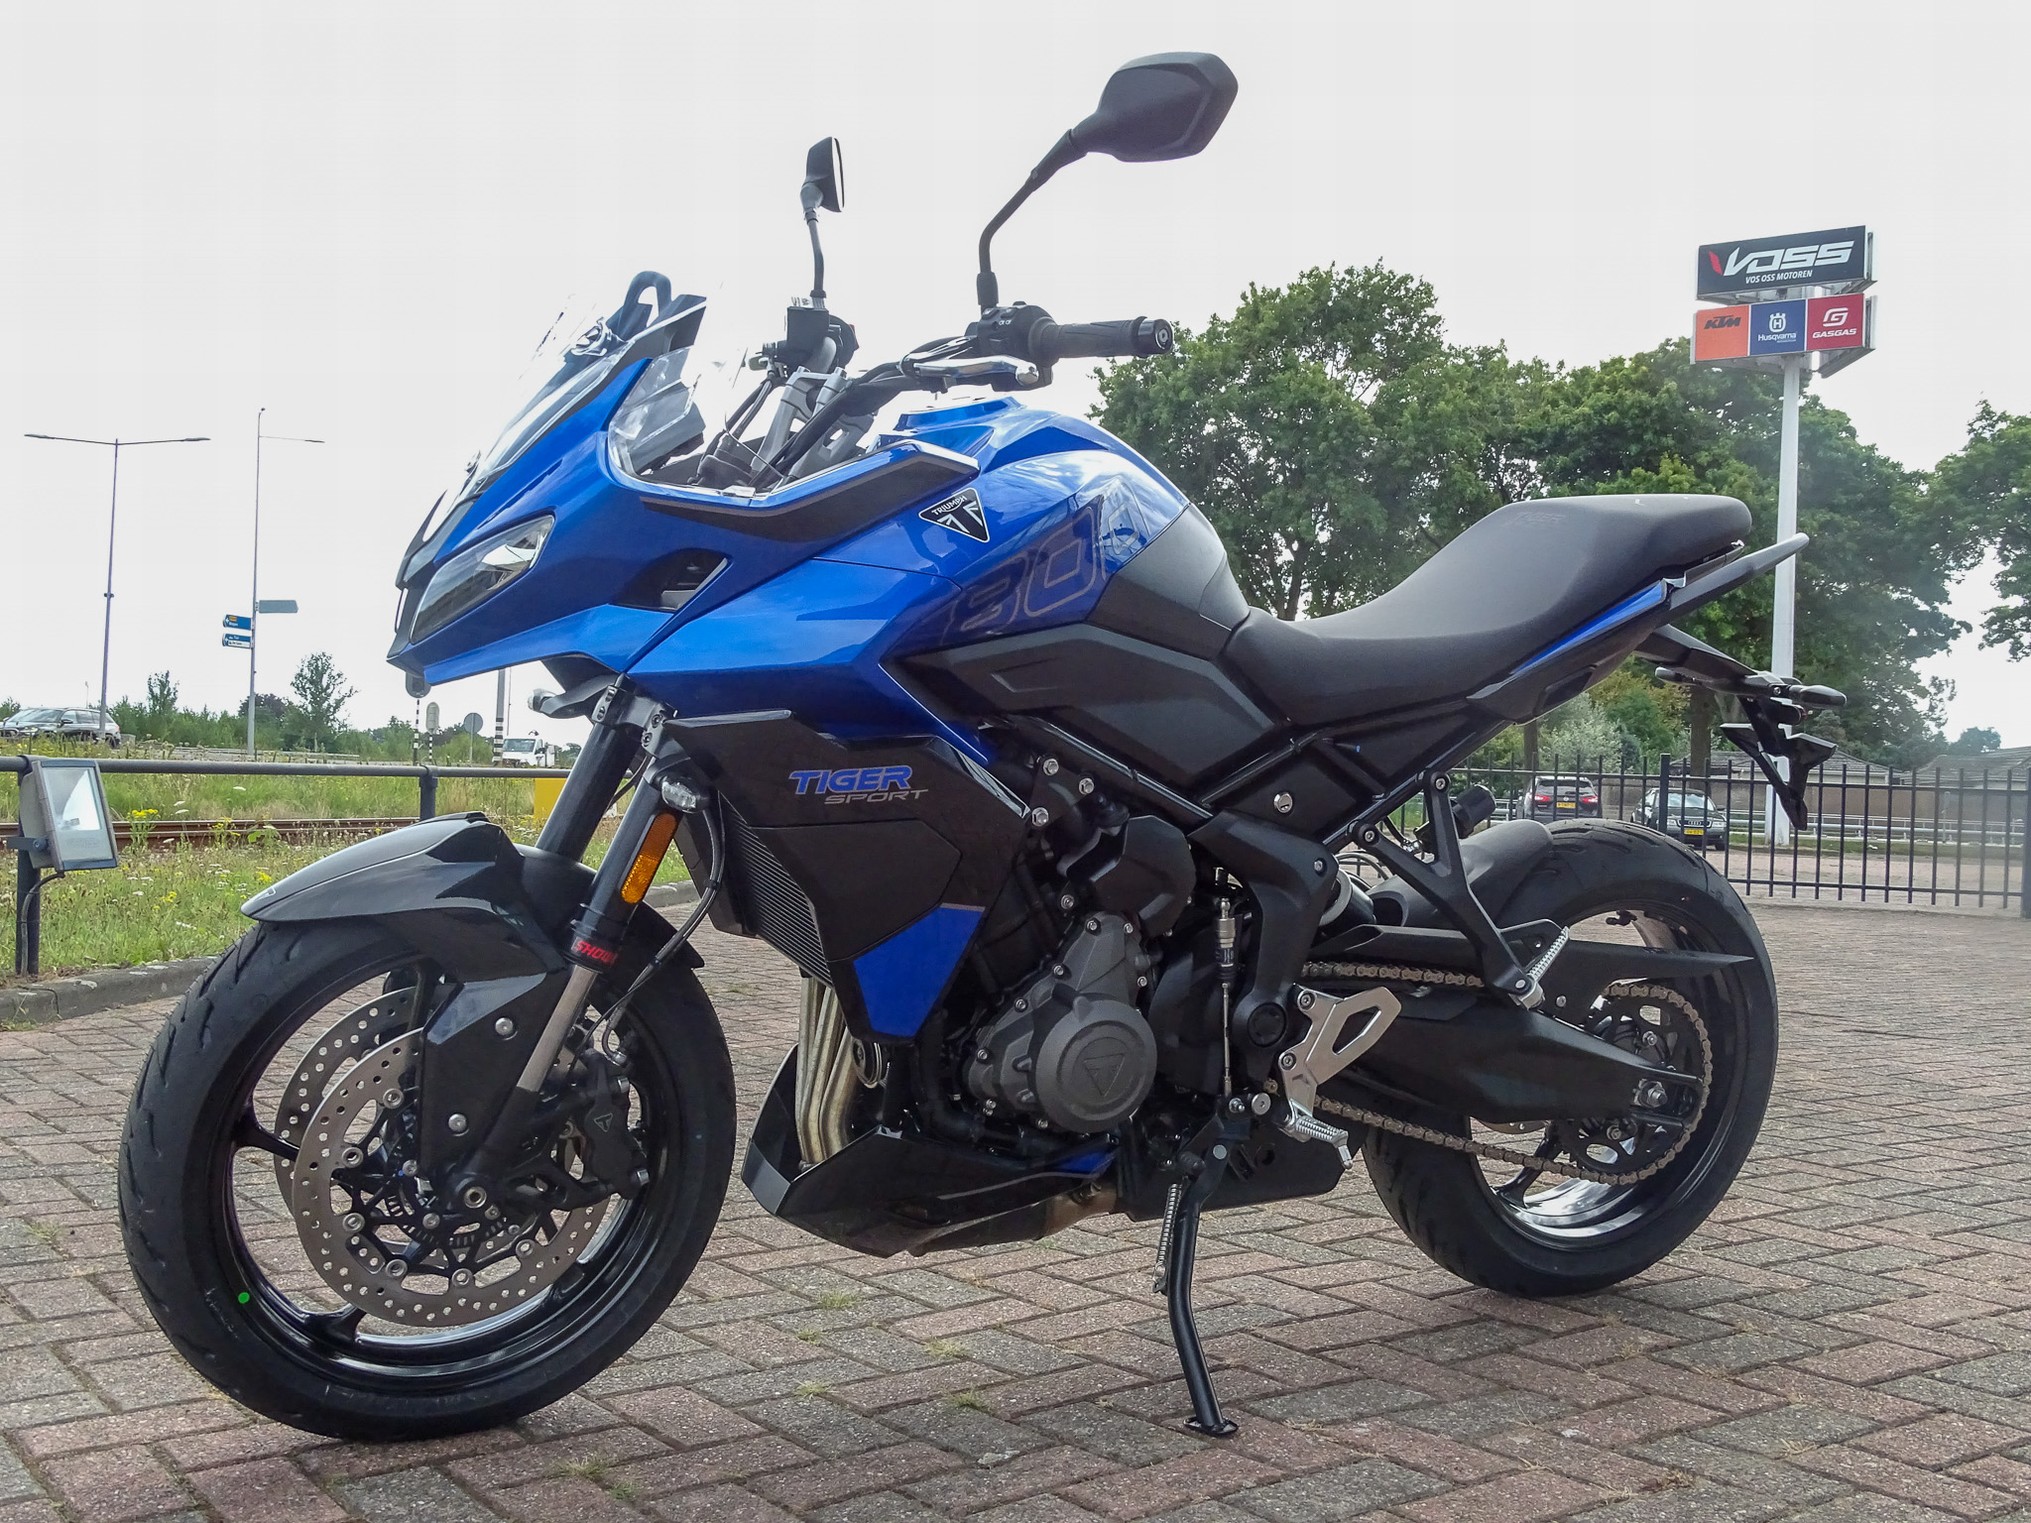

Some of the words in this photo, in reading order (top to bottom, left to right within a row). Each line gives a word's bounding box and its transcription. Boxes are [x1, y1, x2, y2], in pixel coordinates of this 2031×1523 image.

[1708, 241, 1855, 276] VOSS
[1745, 276, 1760, 284] VOS
[1761, 274, 1776, 282] OSS
[1776, 270, 1813, 281] MOTOREN
[1704, 314, 1742, 329] KTM
[1758, 332, 1797, 342] Husqvarna
[1812, 328, 1857, 339] GASGAS
[931, 495, 968, 515] TRIUMPH
[788, 764, 913, 795] TIGER
[824, 788, 929, 805] SPORT
[576, 940, 616, 964] SHOW
